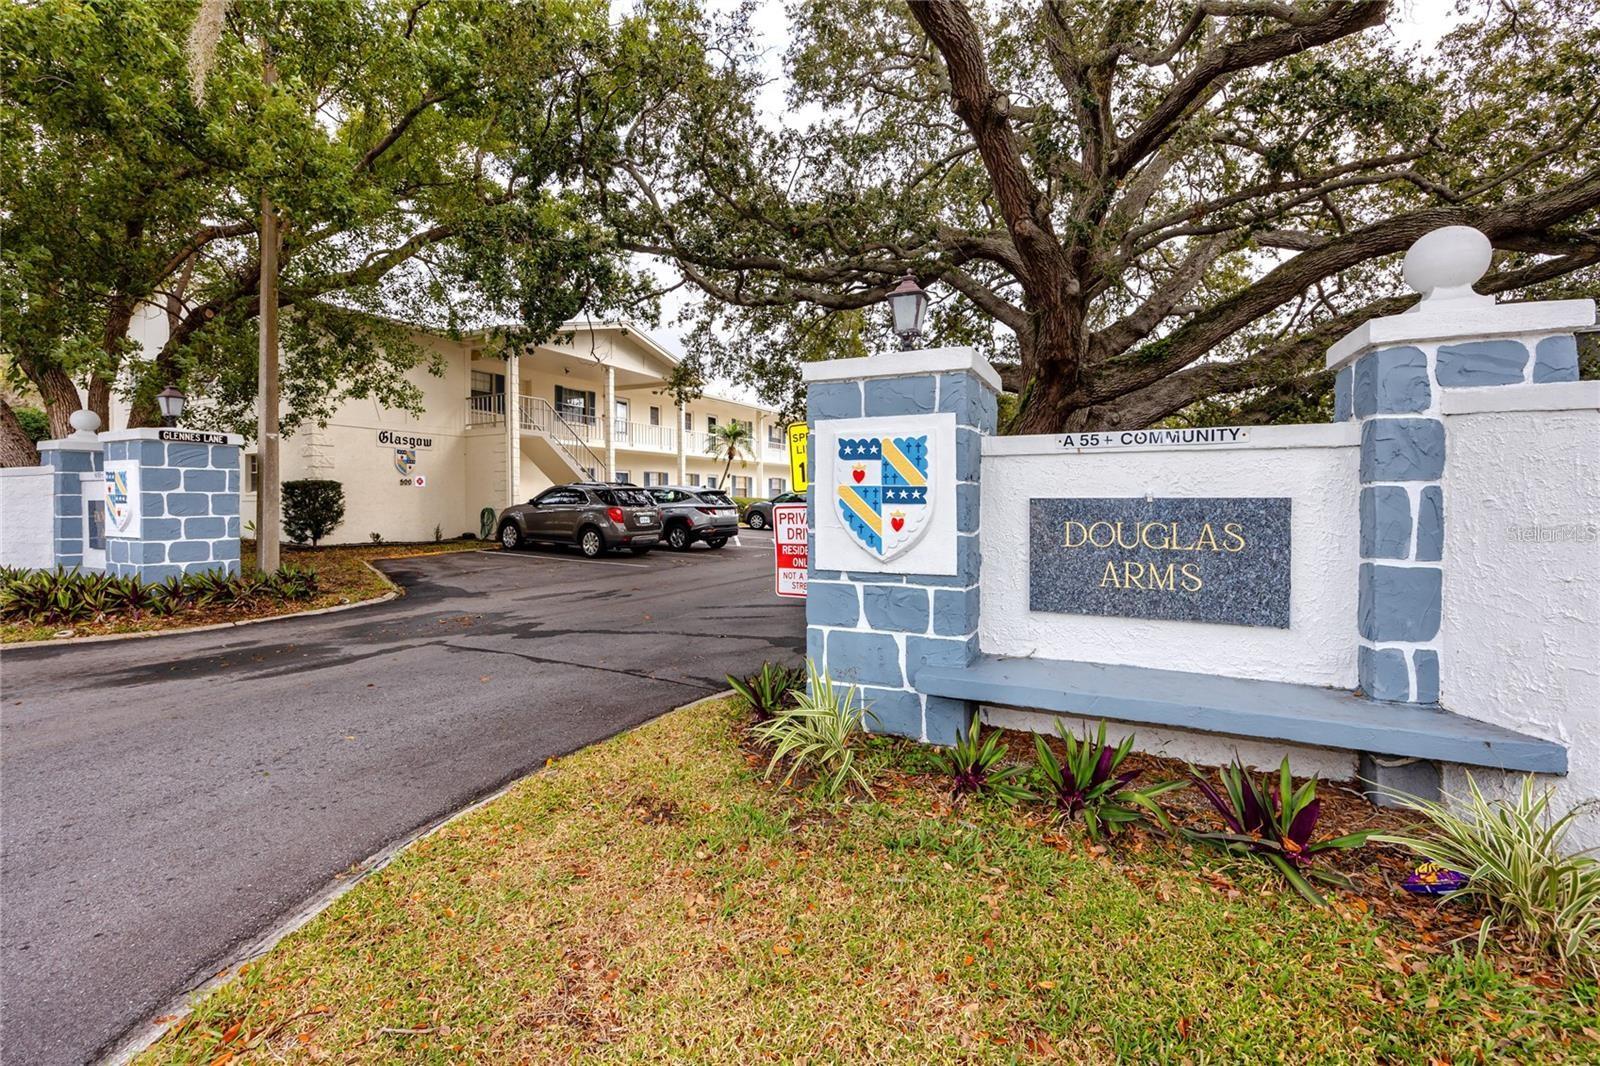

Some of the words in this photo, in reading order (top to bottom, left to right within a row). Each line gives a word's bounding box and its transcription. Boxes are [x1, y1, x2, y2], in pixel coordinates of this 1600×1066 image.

[163, 431, 200, 441] GLENNES
[203, 434, 224, 443] LANE
[378, 430, 432, 448] Glasgow
[1063, 435, 1075, 447] A
[1120, 428, 1241, 445] COMMUNITY
[779, 512, 808, 525] PRIV
[1061, 521, 1246, 552] DOUGLAS
[782, 545, 808, 556] RESIDE
[792, 557, 808, 568] ONL
[783, 571, 797, 580] NOT
[1100, 561, 1203, 592] ARMS
[791, 581, 808, 591] STRE
